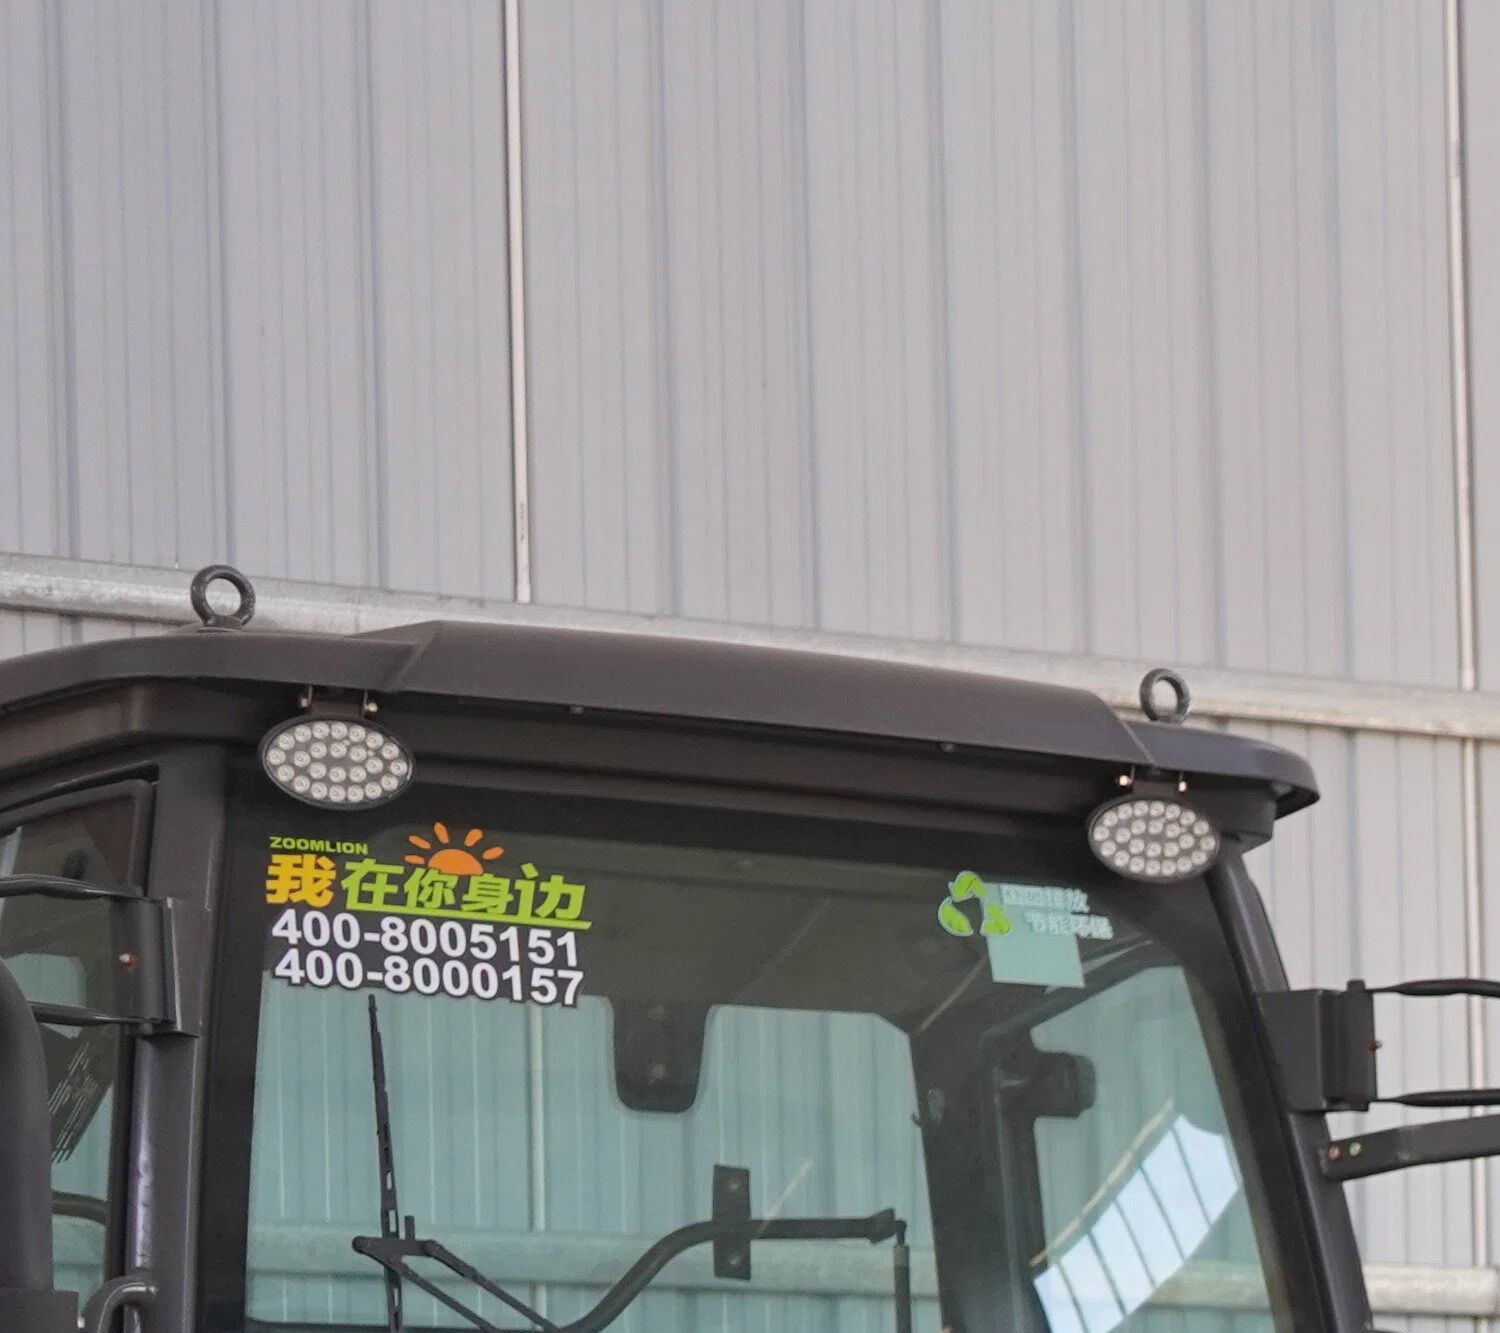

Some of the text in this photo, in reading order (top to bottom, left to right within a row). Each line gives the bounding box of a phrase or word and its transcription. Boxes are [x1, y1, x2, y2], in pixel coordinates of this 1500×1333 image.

[269, 836, 368, 856] ZOOMLION
[265, 854, 587, 920] 我在你身边
[272, 908, 578, 968] 400-8005151
[275, 947, 584, 1006] 400-8000157
